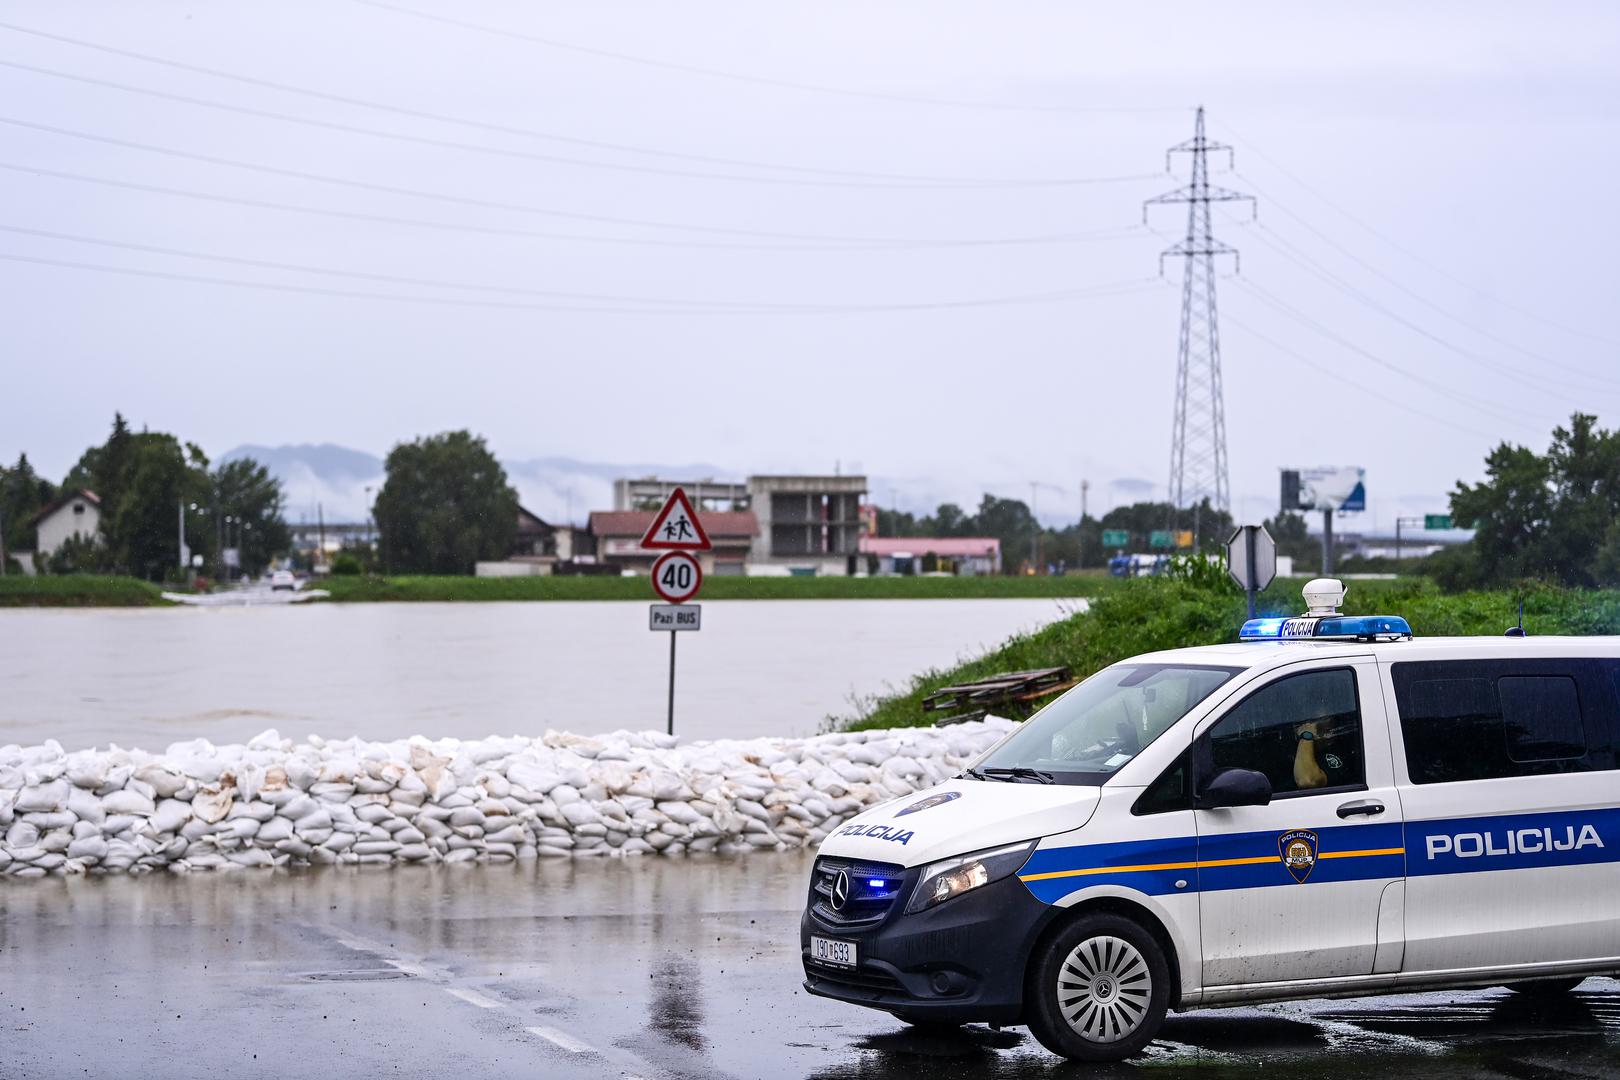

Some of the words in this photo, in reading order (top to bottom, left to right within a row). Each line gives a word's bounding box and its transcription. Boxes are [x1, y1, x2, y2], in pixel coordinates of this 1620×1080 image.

[662, 564, 691, 589] 40
[654, 612, 673, 624] Pazi
[677, 612, 696, 624] BUS
[1283, 622, 1313, 635] POLICIJA
[834, 823, 915, 846] POLICIJA
[1281, 832, 1316, 844] POLICIJA
[1425, 824, 1605, 860] POLICIJA
[816, 939, 828, 958] 190
[834, 942, 849, 962] 693
